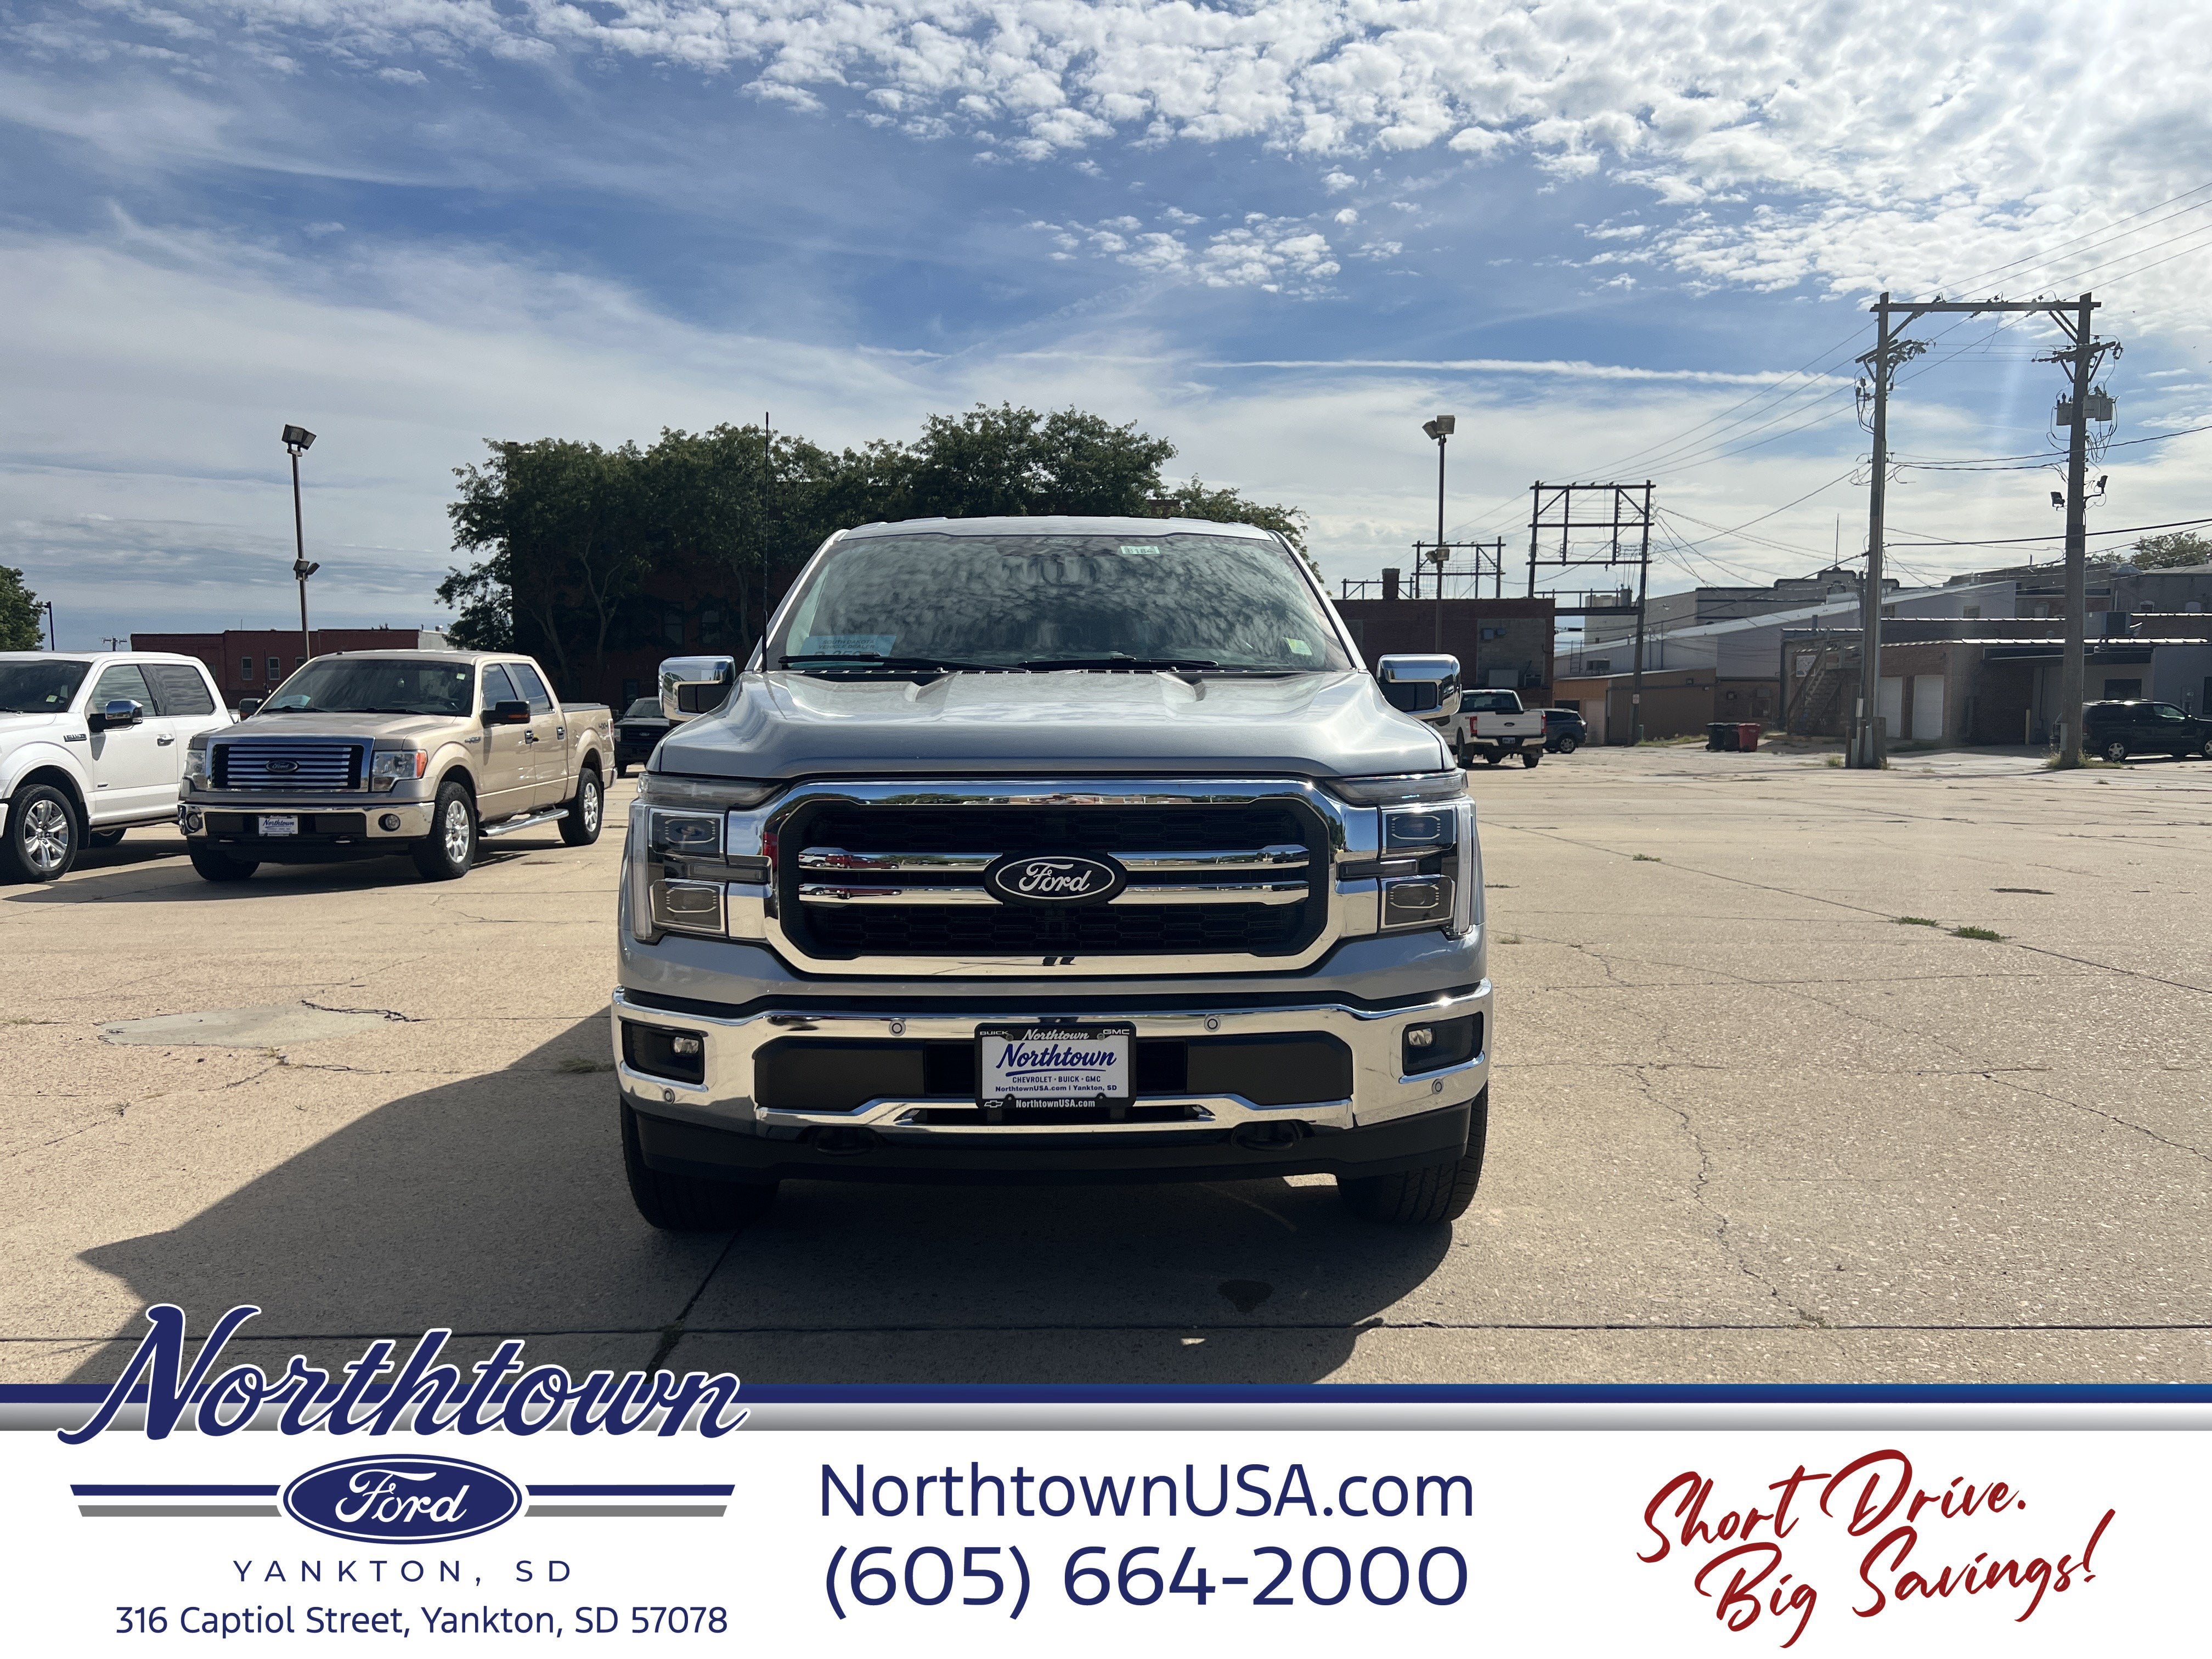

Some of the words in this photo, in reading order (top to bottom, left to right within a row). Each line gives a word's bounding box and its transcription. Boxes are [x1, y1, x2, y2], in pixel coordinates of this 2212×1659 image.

[263, 818, 295, 826] Northtown
[1019, 862, 1092, 891] Ford
[1022, 1029, 1090, 1041] Northtown
[996, 1043, 1117, 1069] Northtown
[1015, 1099, 1096, 1108] NorthtownUSA.com
